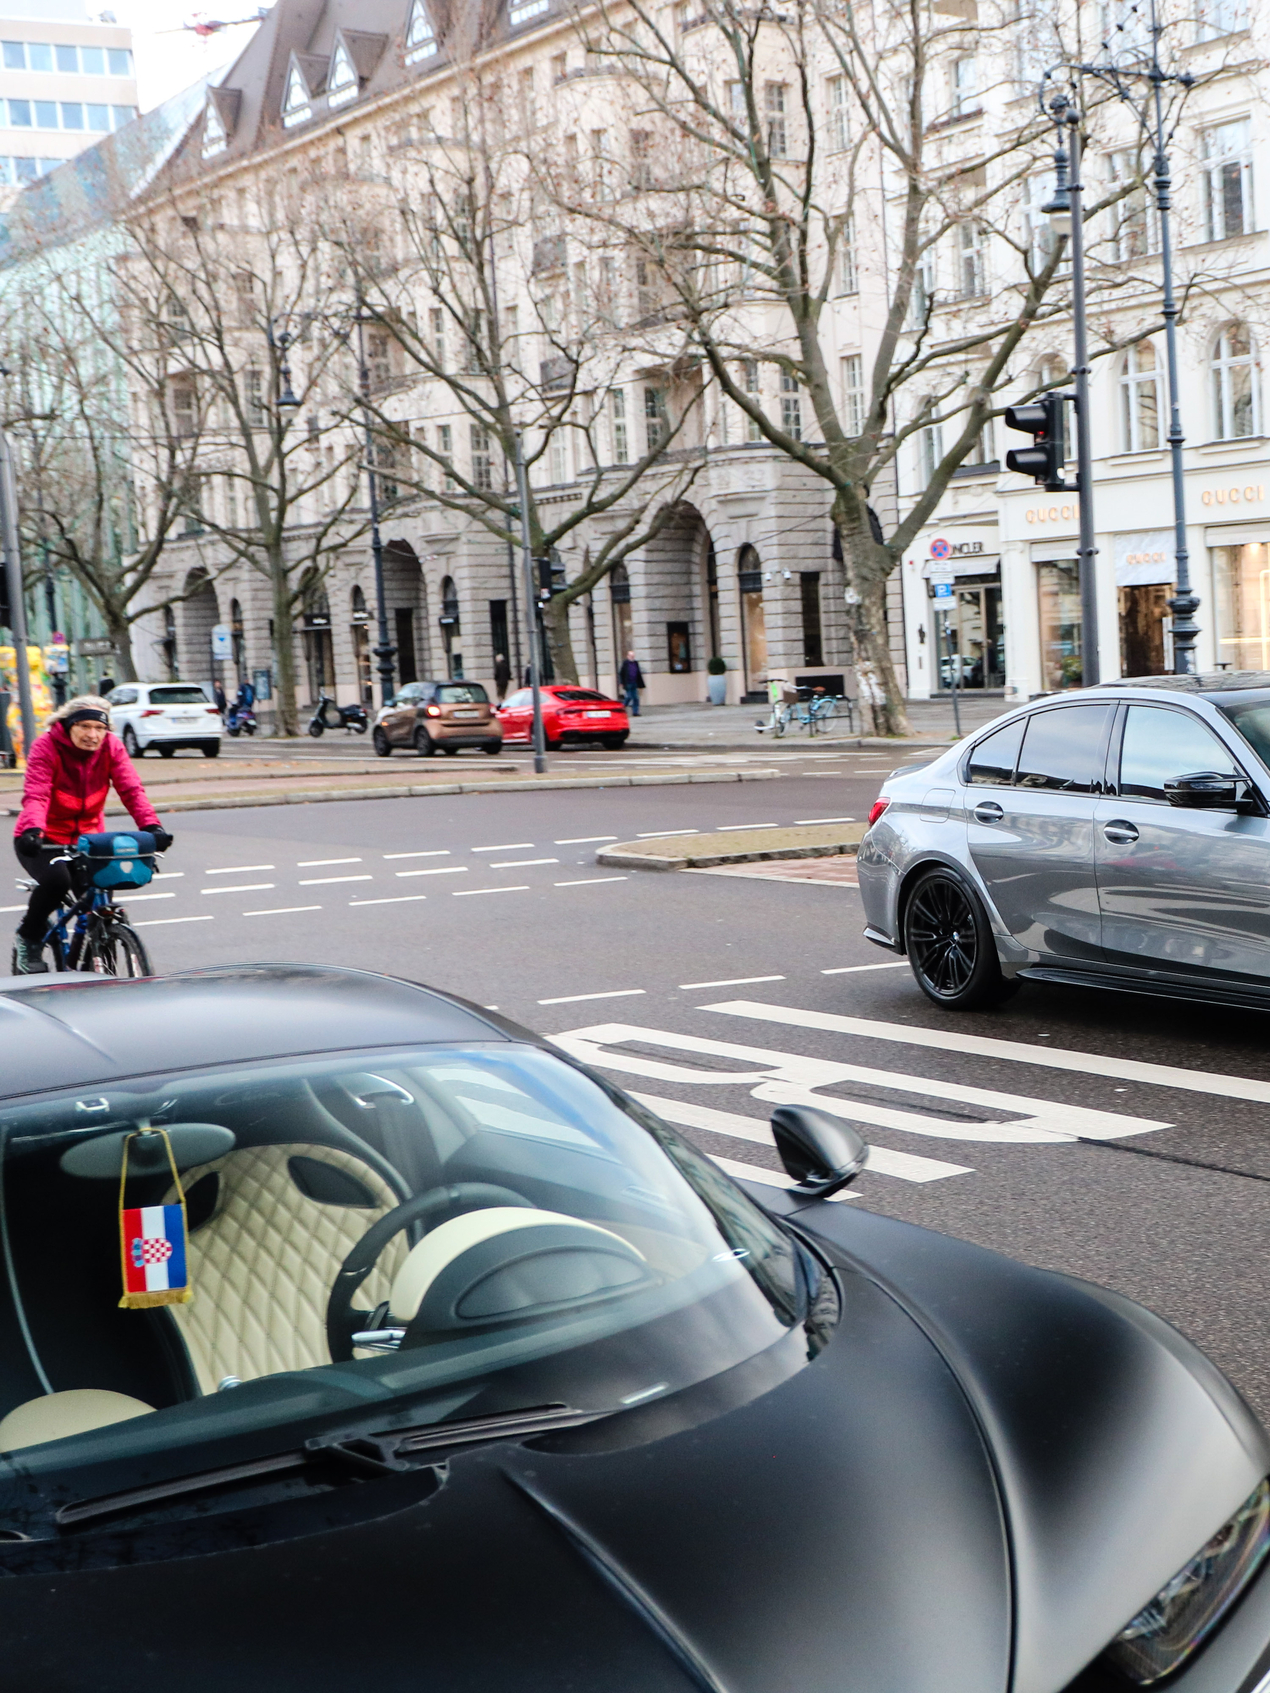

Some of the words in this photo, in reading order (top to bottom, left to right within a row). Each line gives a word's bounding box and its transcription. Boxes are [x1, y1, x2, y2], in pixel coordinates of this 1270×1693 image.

[1201, 485, 1265, 507] GUCCI
[1025, 505, 1080, 524] GUCCI
[1126, 552, 1166, 565] GUCCI
